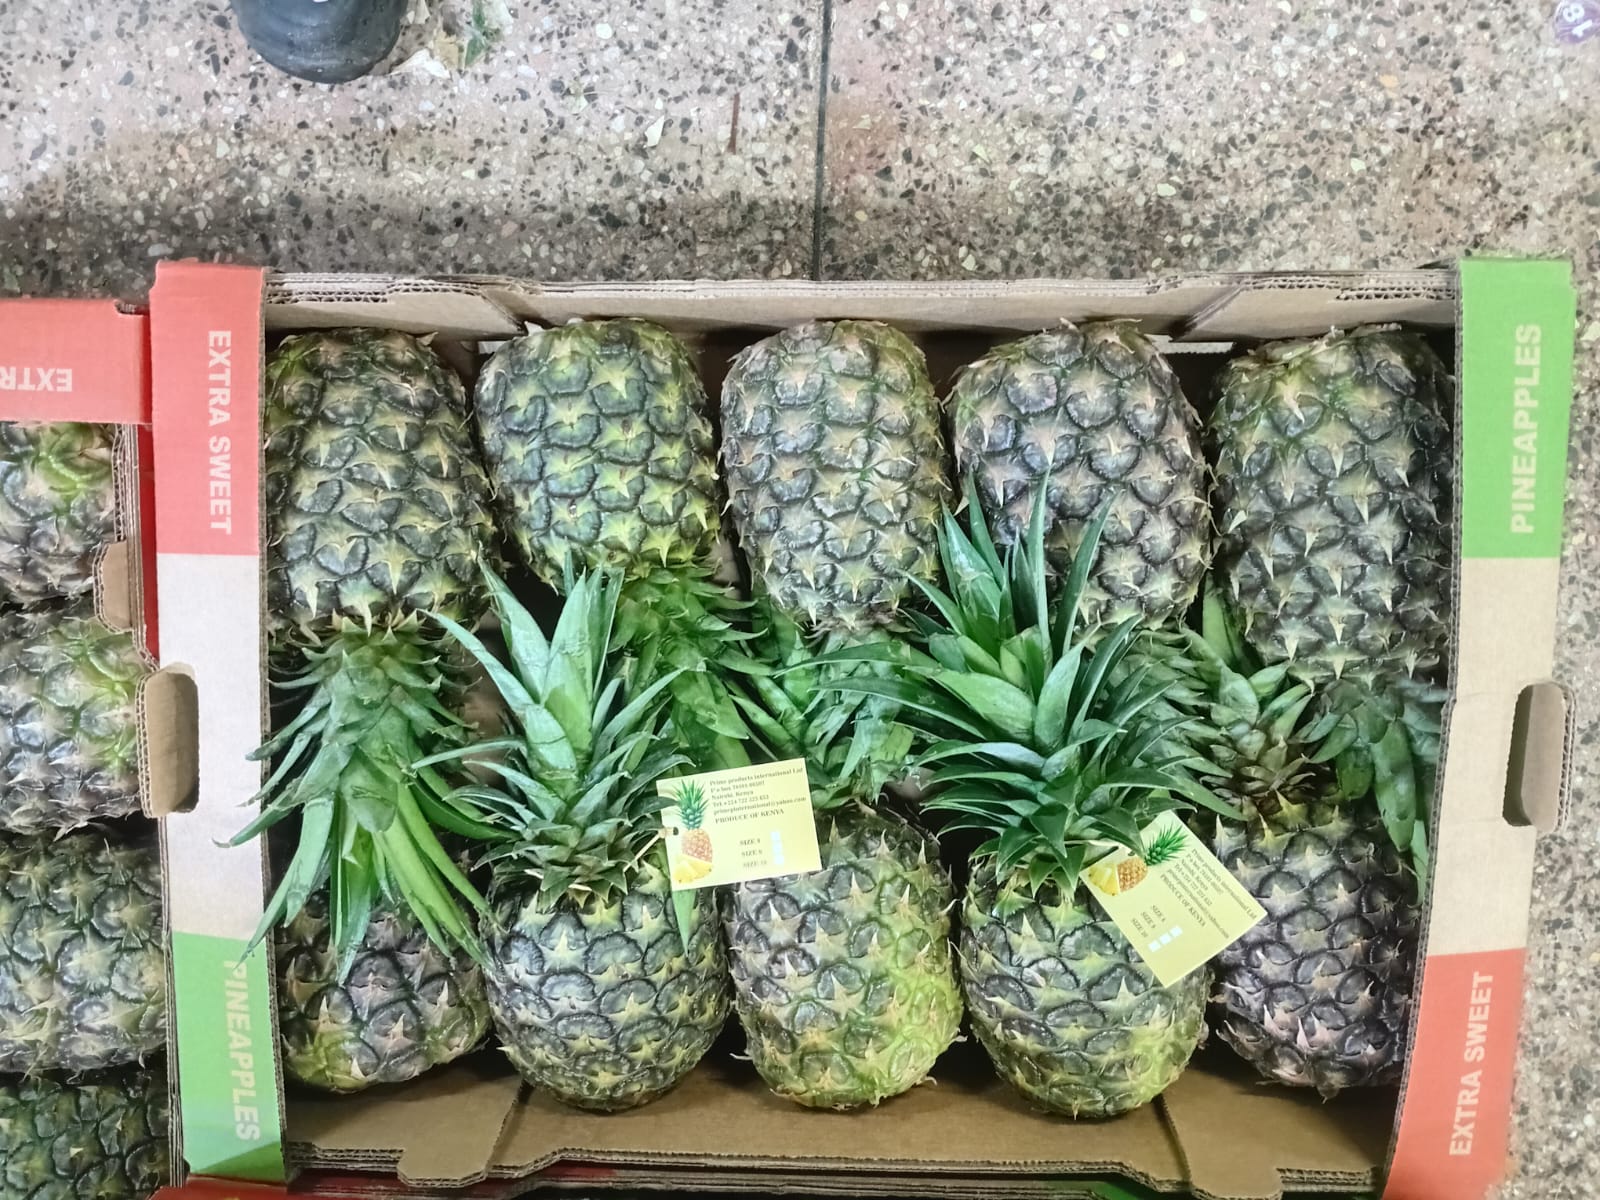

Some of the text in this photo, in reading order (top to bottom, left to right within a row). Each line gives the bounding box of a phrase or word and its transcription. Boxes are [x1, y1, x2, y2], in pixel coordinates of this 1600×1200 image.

[208, 331, 233, 536] EXTRA SWEET
[1511, 324, 1542, 535] PINEAPPLES
[716, 814, 748, 824] PRODUCE
[761, 809, 784, 818] KENYA
[1132, 918, 1143, 931] SIZE
[1142, 911, 1154, 924] SIZE
[1152, 905, 1162, 917] SIZE
[1160, 874, 1205, 926] PRODUCE OF KENYA
[224, 959, 260, 1142] PINEAPPLES
[1450, 971, 1495, 1157] EXTRA SWEET
